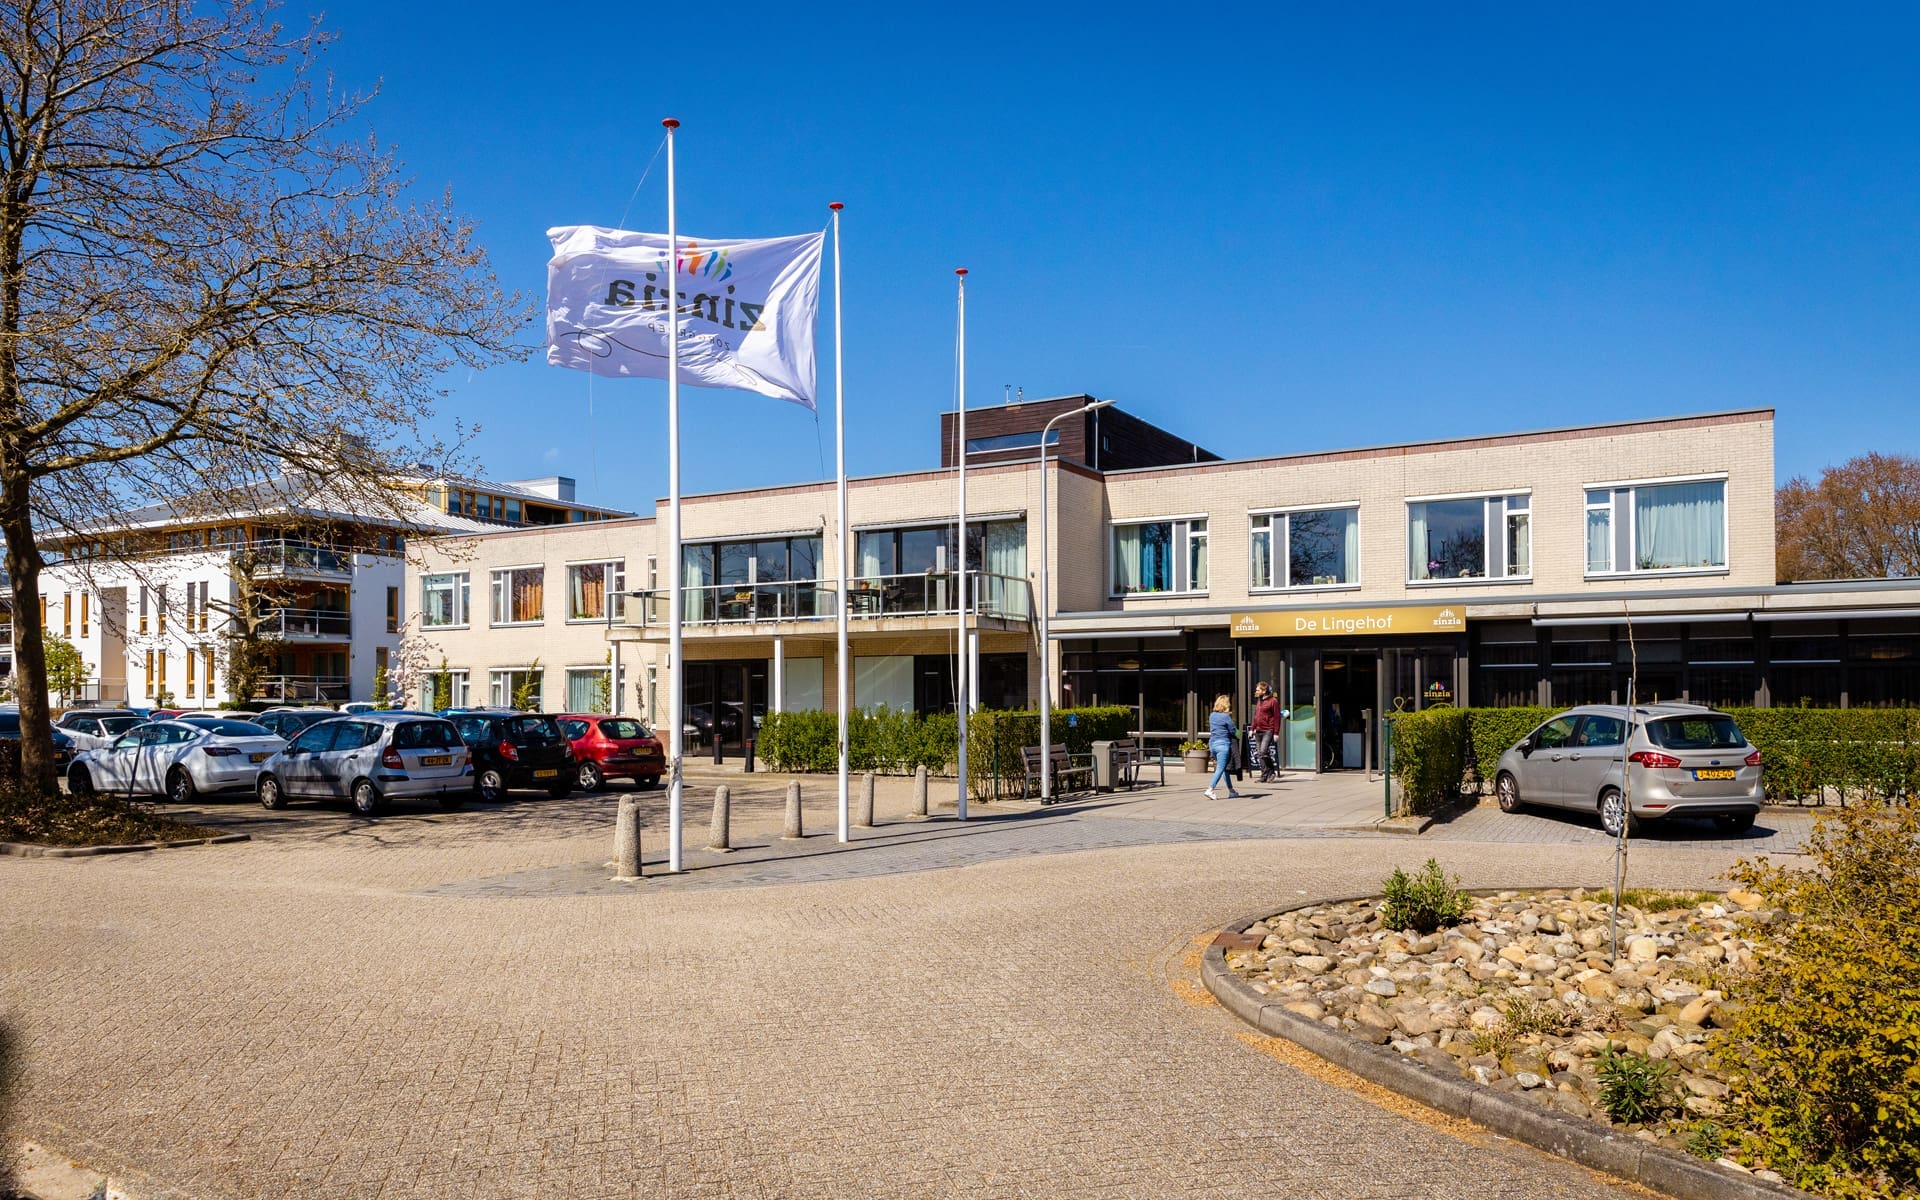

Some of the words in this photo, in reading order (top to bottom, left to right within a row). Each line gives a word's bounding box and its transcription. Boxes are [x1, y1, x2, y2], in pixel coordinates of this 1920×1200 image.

[1295, 617, 1317, 631] De
[1322, 614, 1393, 633] Lingehof
[1433, 616, 1462, 625] zinzia
[1235, 623, 1260, 632] zinzia
[1423, 690, 1451, 698] zinzia
